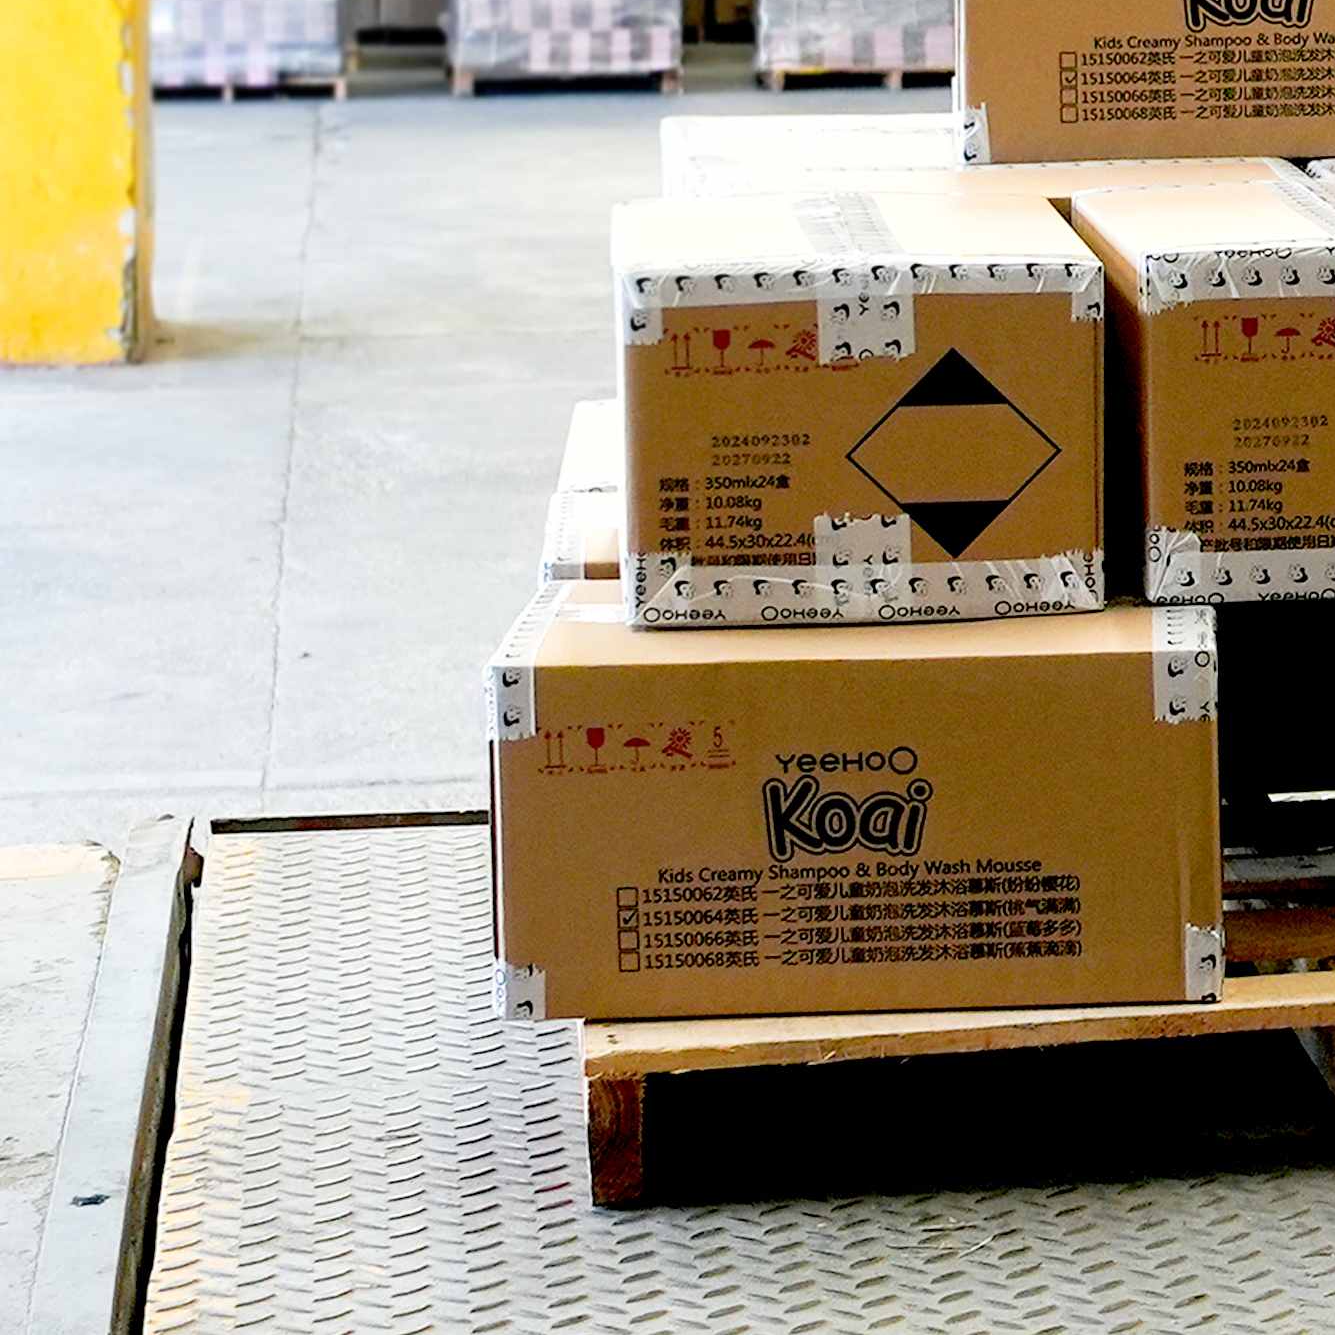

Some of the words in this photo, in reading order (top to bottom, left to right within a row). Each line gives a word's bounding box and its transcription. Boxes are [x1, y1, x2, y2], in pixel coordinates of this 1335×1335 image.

[1094, 37, 1123, 50] Kids
[1127, 36, 1181, 51] Creamy
[1185, 34, 1252, 49] Shampoo
[1257, 33, 1270, 45] &
[1274, 32, 1309, 49] Body
[1228, 479, 1283, 495] 10.08kg
[705, 496, 762, 512] 10.08kg
[1228, 498, 1283, 514] 11.74kg
[705, 515, 762, 531] 11.74kg
[762, 775, 934, 861] Koai
[658, 868, 694, 883] Kids
[699, 867, 763, 885] Creamy
[768, 865, 850, 882] Shampoo
[855, 862, 872, 877] &
[876, 861, 919, 880] Body
[924, 859, 971, 875] Wash
[976, 859, 1042, 874] Mousse
